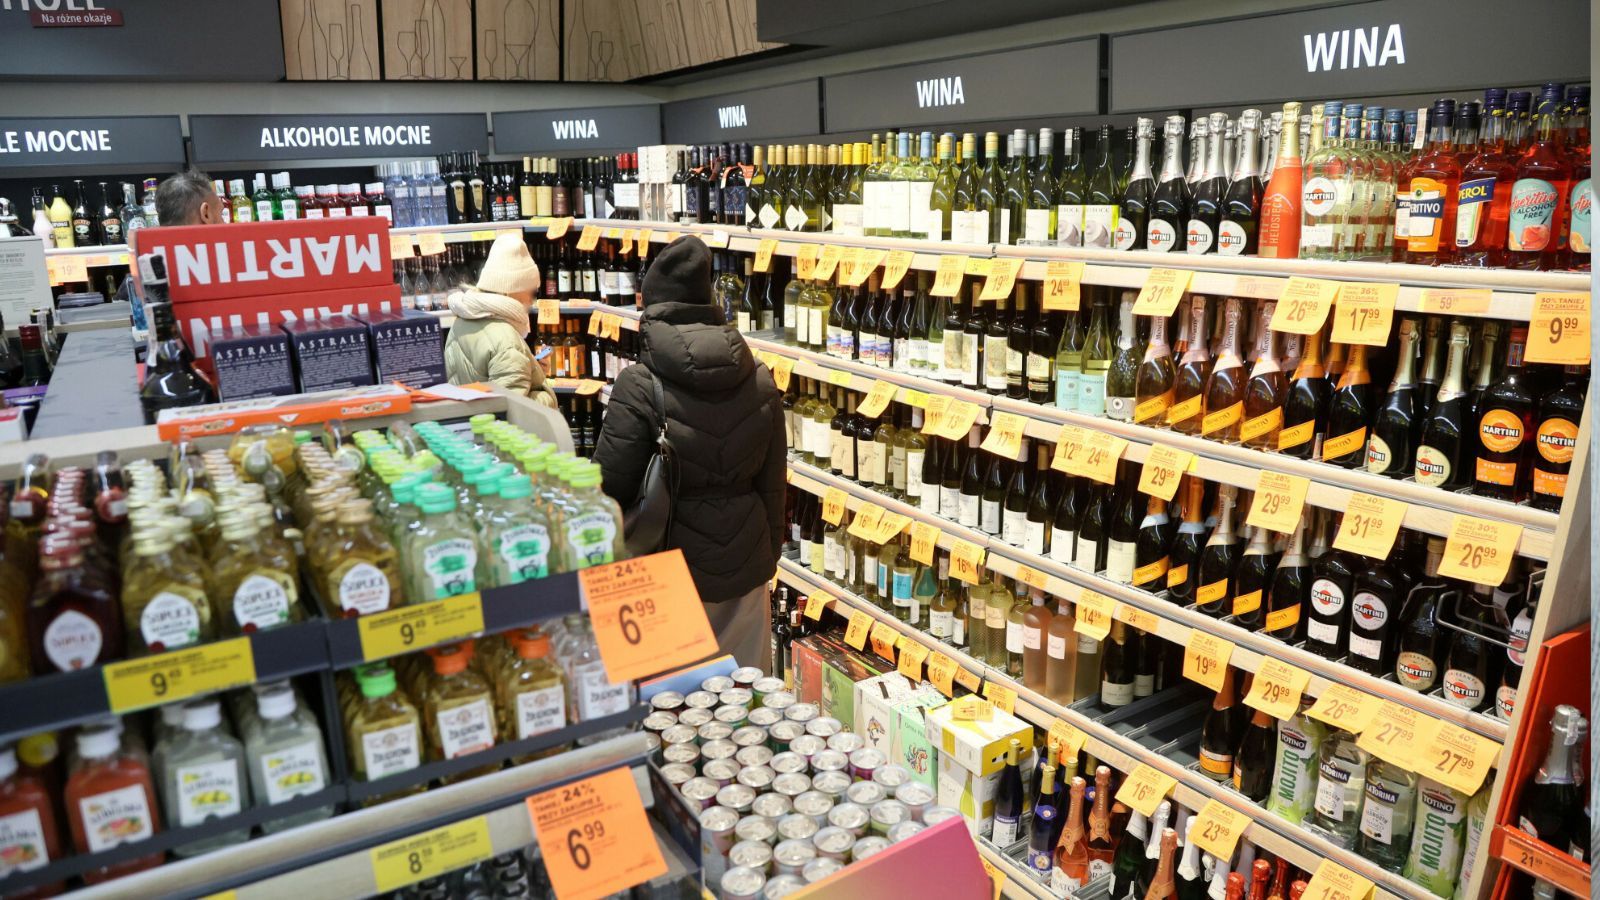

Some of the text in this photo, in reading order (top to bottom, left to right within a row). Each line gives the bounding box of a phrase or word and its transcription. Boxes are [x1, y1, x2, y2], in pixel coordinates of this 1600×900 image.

[41, 12, 112, 25] Na różne okazje
[1303, 23, 1406, 73] WINA
[916, 75, 965, 109] WINA
[718, 104, 748, 129] WINA
[260, 125, 432, 149] ALKOHOLE MOCNE
[552, 119, 599, 141] WINA
[25, 129, 112, 153] MOCNE
[1304, 191, 1335, 201] MARTINI
[1523, 211, 1544, 220] FREE
[1149, 233, 1171, 242] ARTINI
[1219, 235, 1242, 245] ARTINI
[375, 323, 441, 340] ASTRALE
[215, 341, 287, 361] ASTRALE
[298, 333, 367, 351] ASTRALE
[1483, 425, 1520, 438] MARTINI
[614, 559, 648, 579] 24%
[1311, 587, 1342, 606] MARTINI
[1354, 602, 1385, 620] MARTINI
[1399, 662, 1433, 680] MARTINI
[1445, 679, 1480, 699] MARTINI
[1281, 733, 1306, 751] TOTINO
[1278, 749, 1301, 802] MOJITO
[561, 782, 596, 802] 24%
[1422, 794, 1455, 814] TOTINO
[1420, 811, 1447, 872] MOJITO
